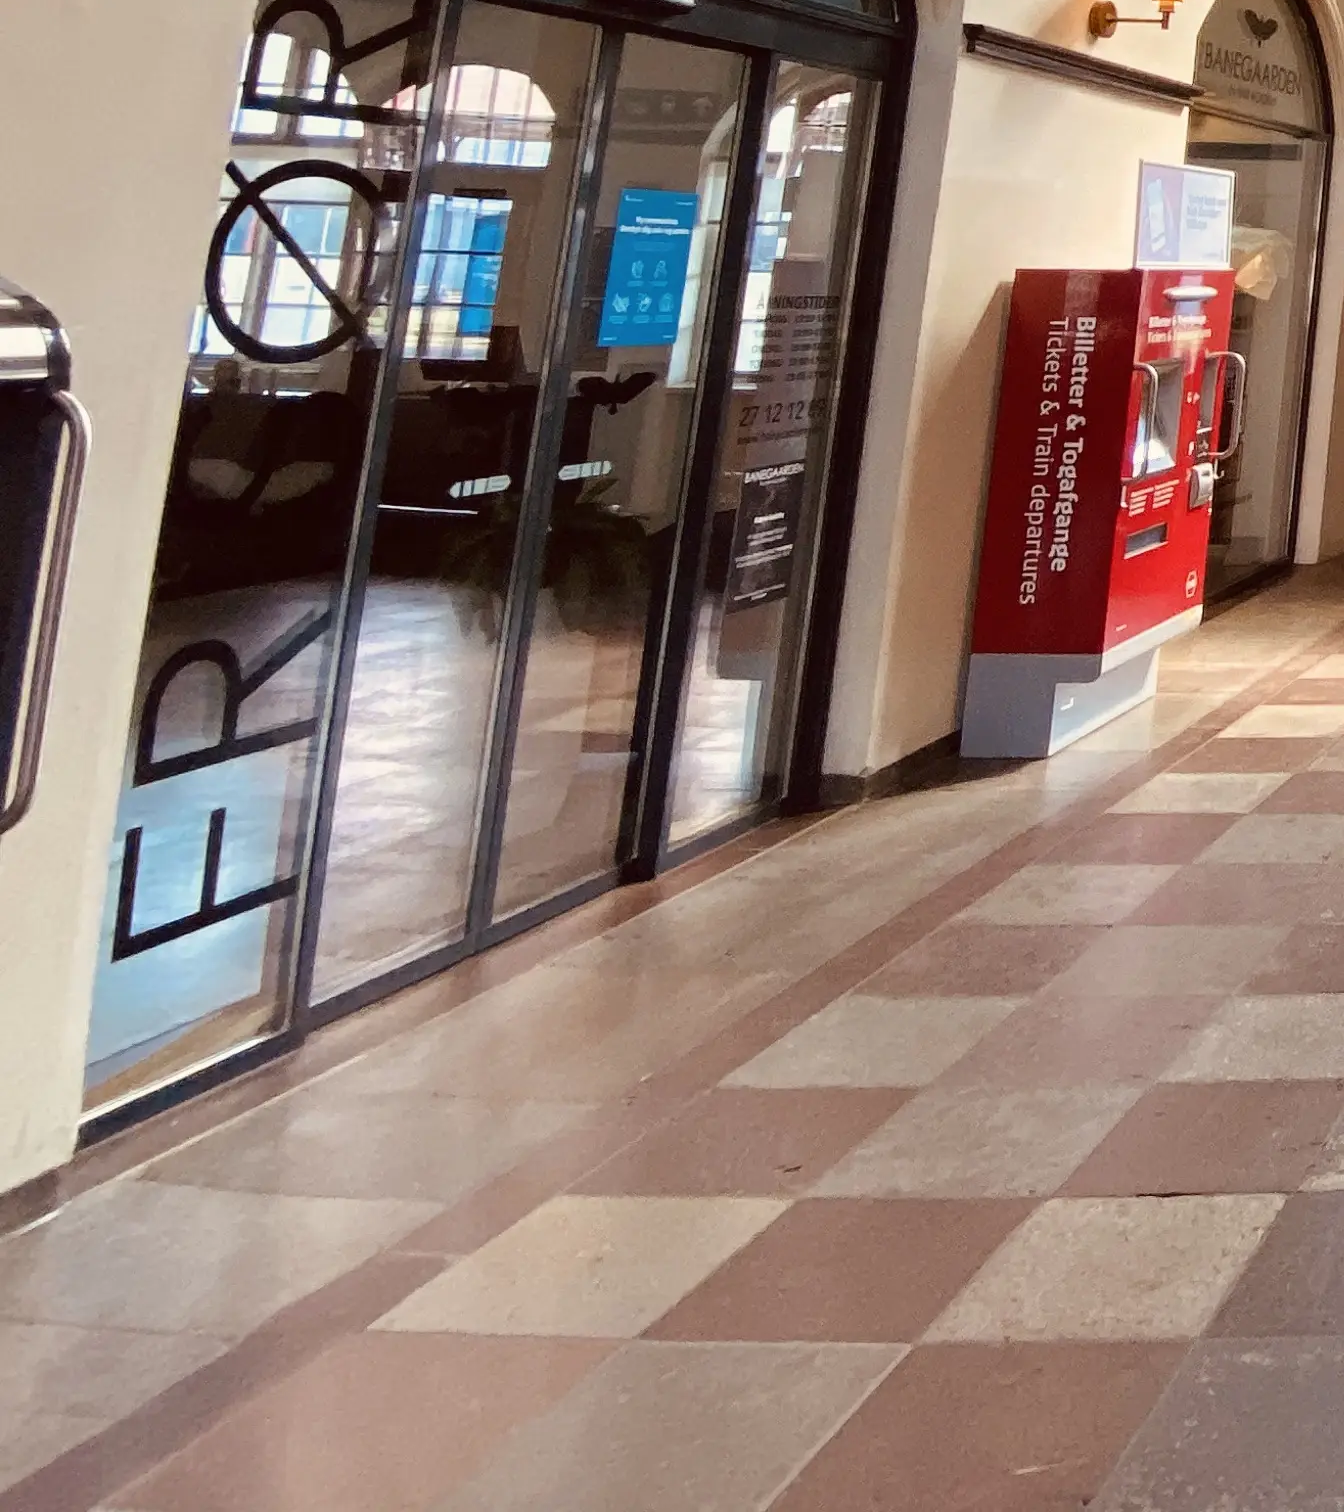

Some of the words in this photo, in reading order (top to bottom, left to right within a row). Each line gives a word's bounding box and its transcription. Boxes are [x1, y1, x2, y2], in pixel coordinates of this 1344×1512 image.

[1041, 316, 1070, 393] Tickets
[1068, 316, 1098, 408] Billetter
[764, 402, 784, 424] 12
[787, 400, 805, 420] 12
[1039, 398, 1061, 416] &
[1066, 413, 1087, 432] &
[1033, 423, 1058, 477] Train
[1050, 437, 1084, 573] Togafgange
[1019, 484, 1051, 606] departures
